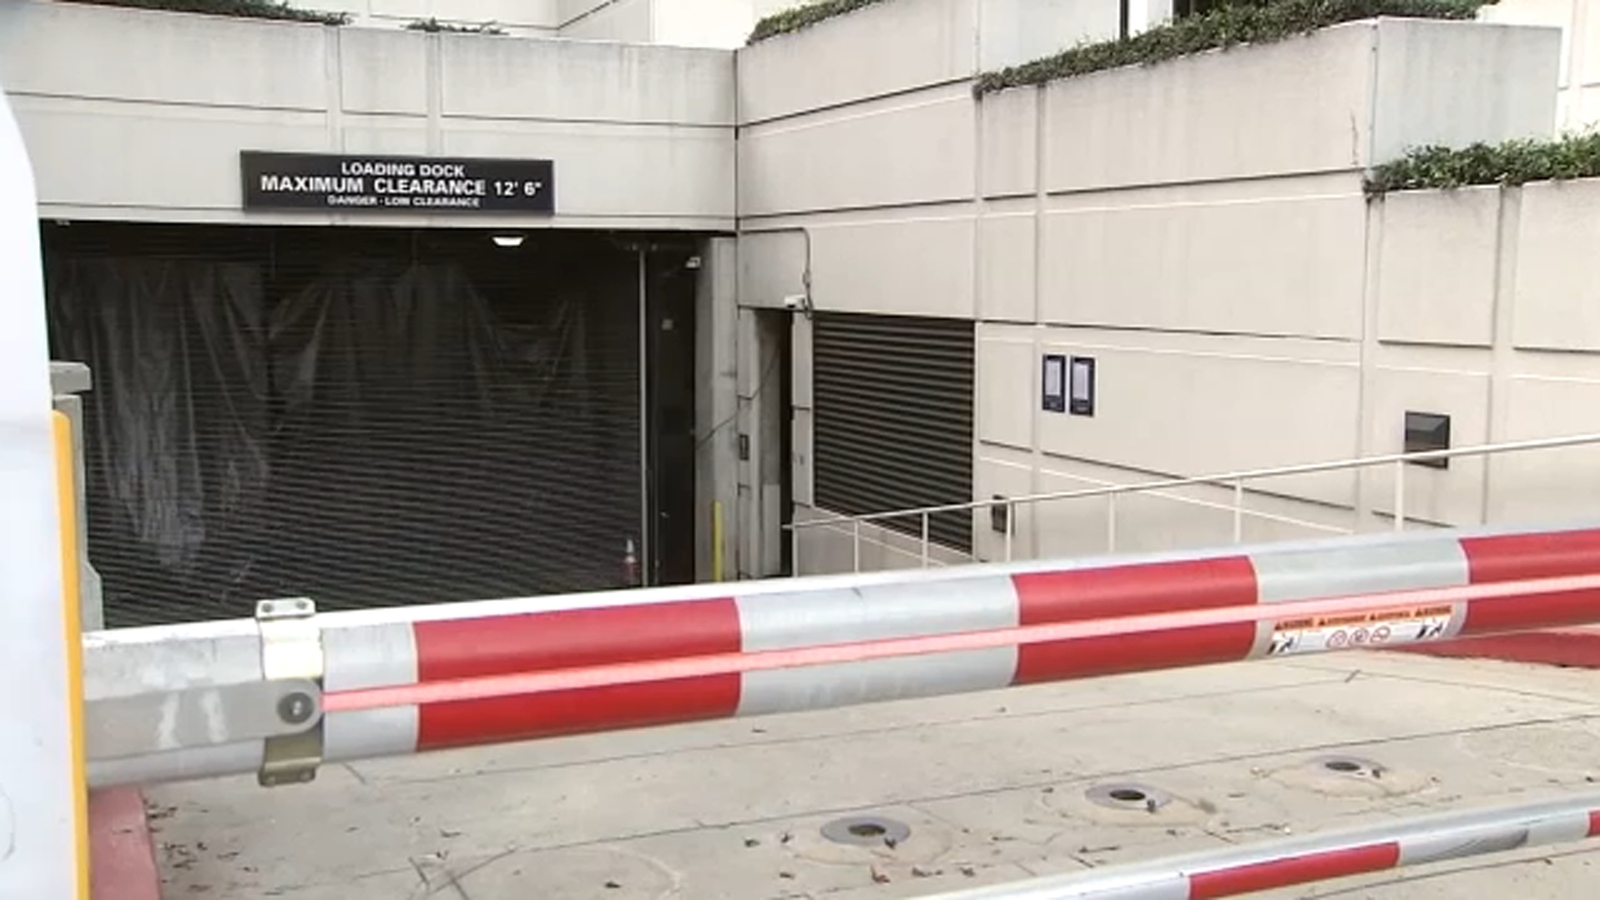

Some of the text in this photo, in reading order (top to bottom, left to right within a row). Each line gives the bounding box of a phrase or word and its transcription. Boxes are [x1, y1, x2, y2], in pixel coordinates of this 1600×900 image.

[341, 162, 465, 177] LOADING DOCK
[261, 175, 363, 193] MAXIMUM
[374, 178, 486, 195] CLEARANCE
[494, 181, 518, 196] 12'
[327, 195, 378, 205] DANGER
[413, 197, 480, 207] CLEARANCE
